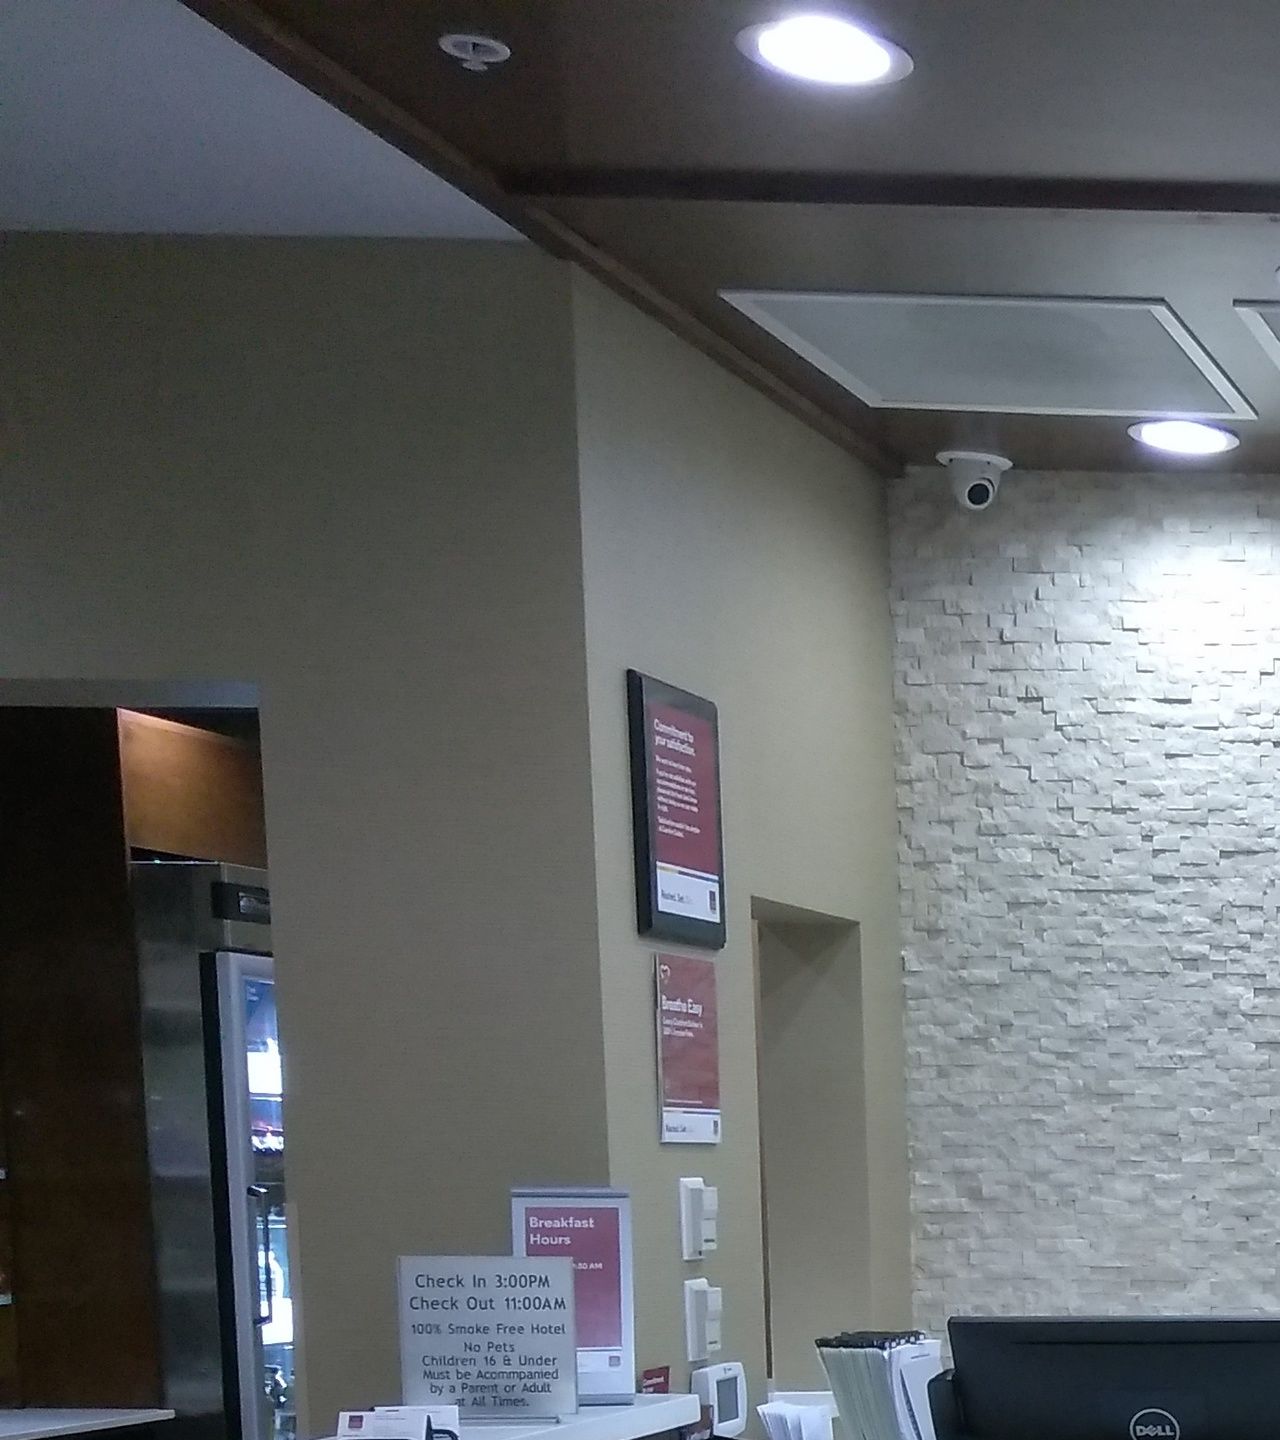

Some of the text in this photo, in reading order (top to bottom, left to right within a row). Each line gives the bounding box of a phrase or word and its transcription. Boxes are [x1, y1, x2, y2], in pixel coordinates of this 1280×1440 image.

[529, 1216, 595, 1229] Breakfast
[529, 1234, 572, 1246] Hours
[415, 1274, 550, 1289] Check In 3:00PM
[409, 1296, 567, 1311] Check Out 11:00AM
[411, 1323, 566, 1335] 100% Smoke Free Hotel
[464, 1342, 515, 1353] No Pets
[422, 1355, 558, 1367] Children 16 & Under
[423, 1369, 451, 1380] Must
[456, 1369, 472, 1380] be
[430, 1383, 552, 1396] by a Parent or Adult
[455, 1396, 530, 1407] at All Times.
[1135, 1424, 1175, 1437] DELL
